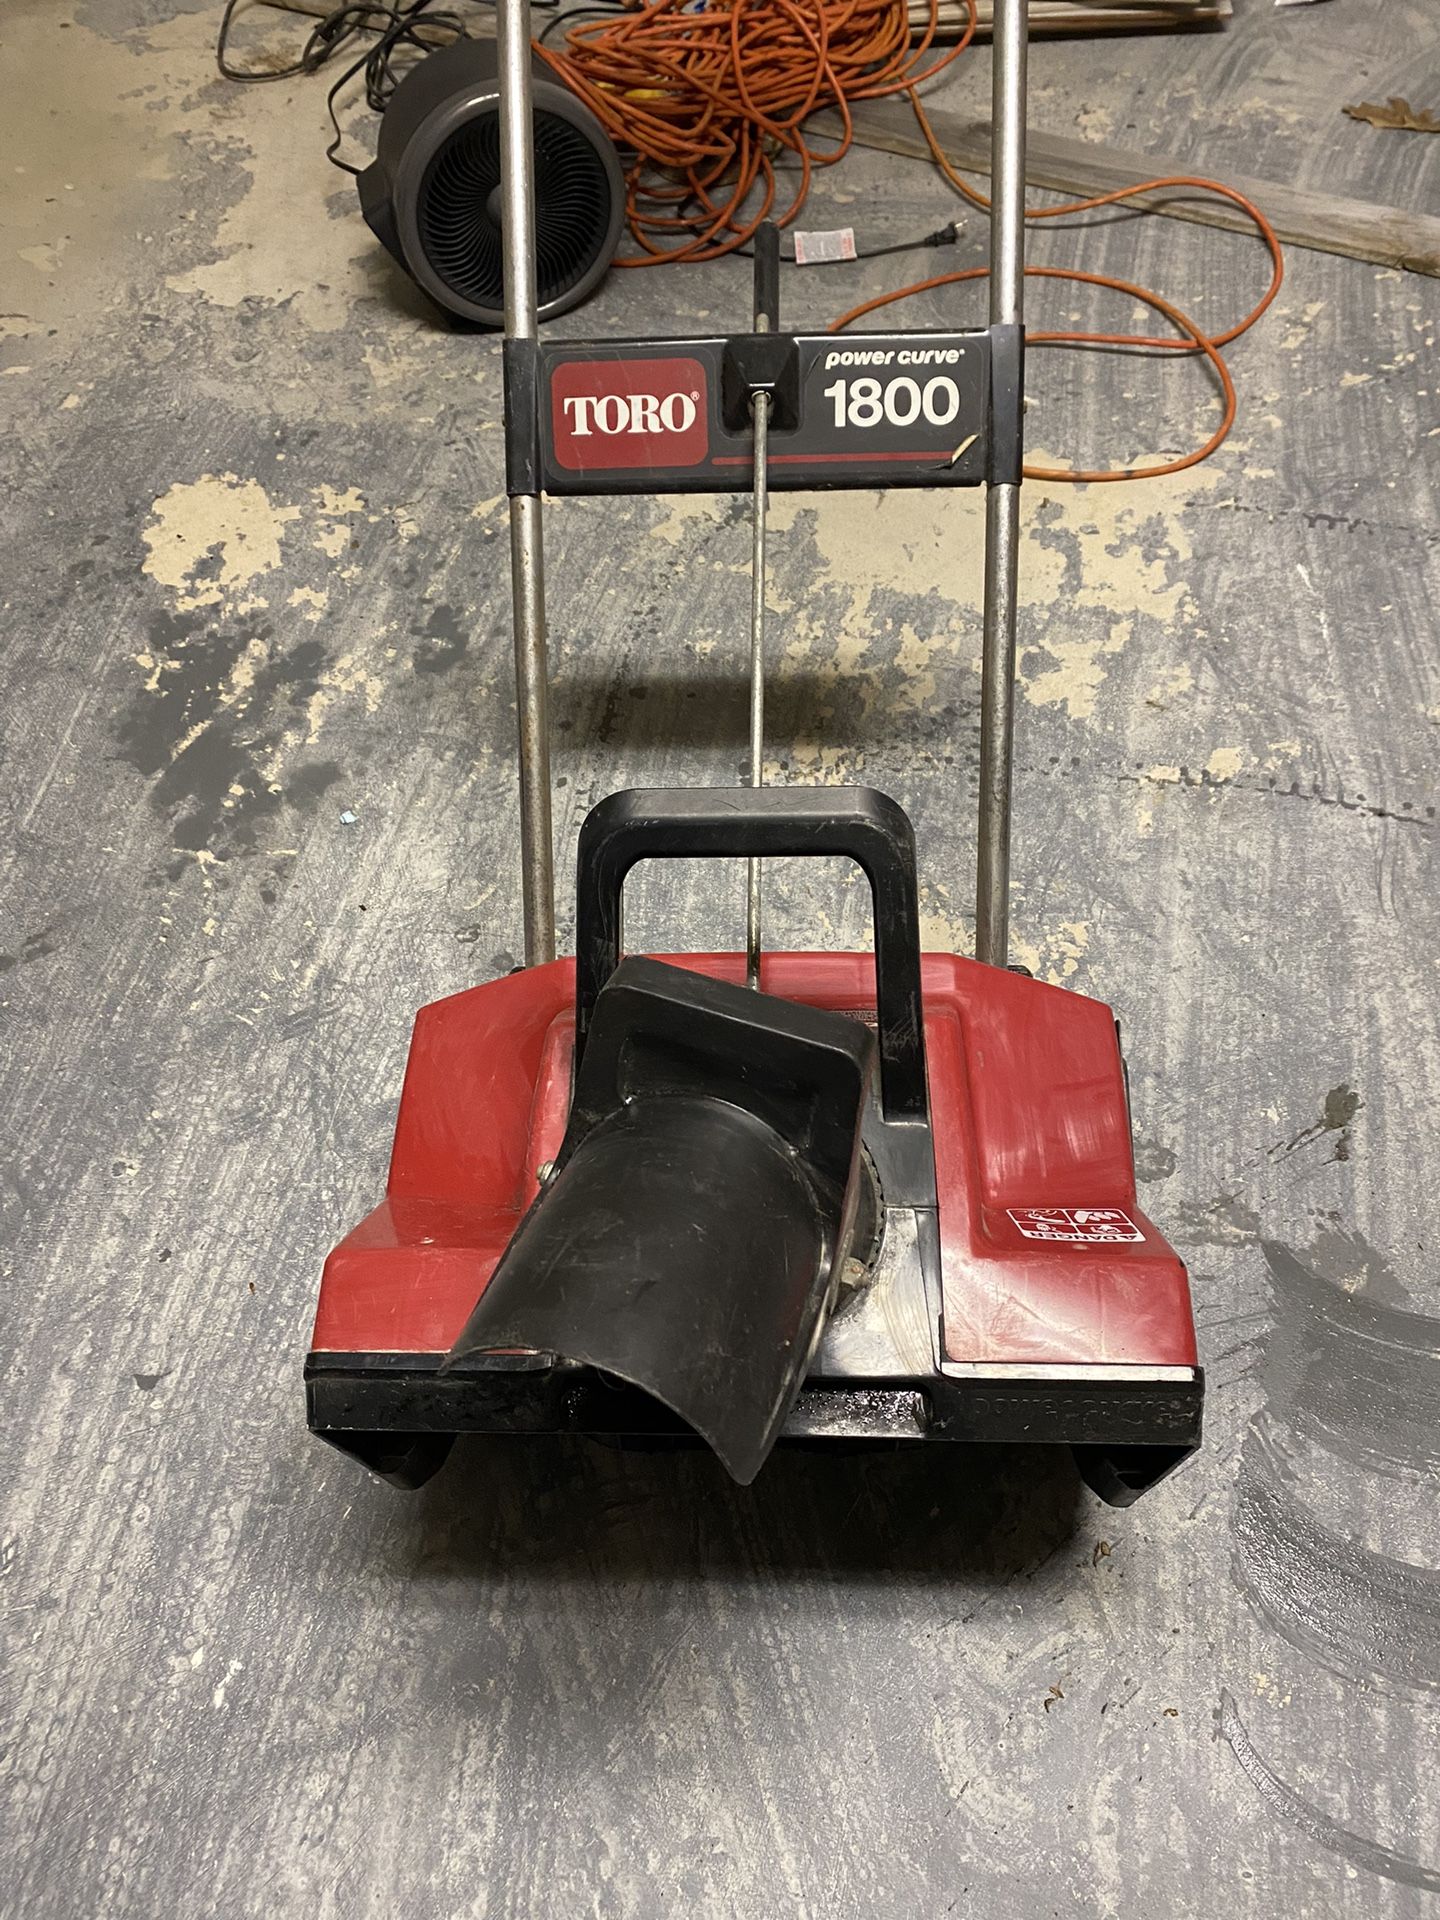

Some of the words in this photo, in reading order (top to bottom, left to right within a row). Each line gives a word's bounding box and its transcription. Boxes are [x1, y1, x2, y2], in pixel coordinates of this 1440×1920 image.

[825, 351, 895, 370] power
[897, 349, 961, 365] curve
[824, 376, 960, 428] 1800
[1030, 1231, 1118, 1241] DANGER
